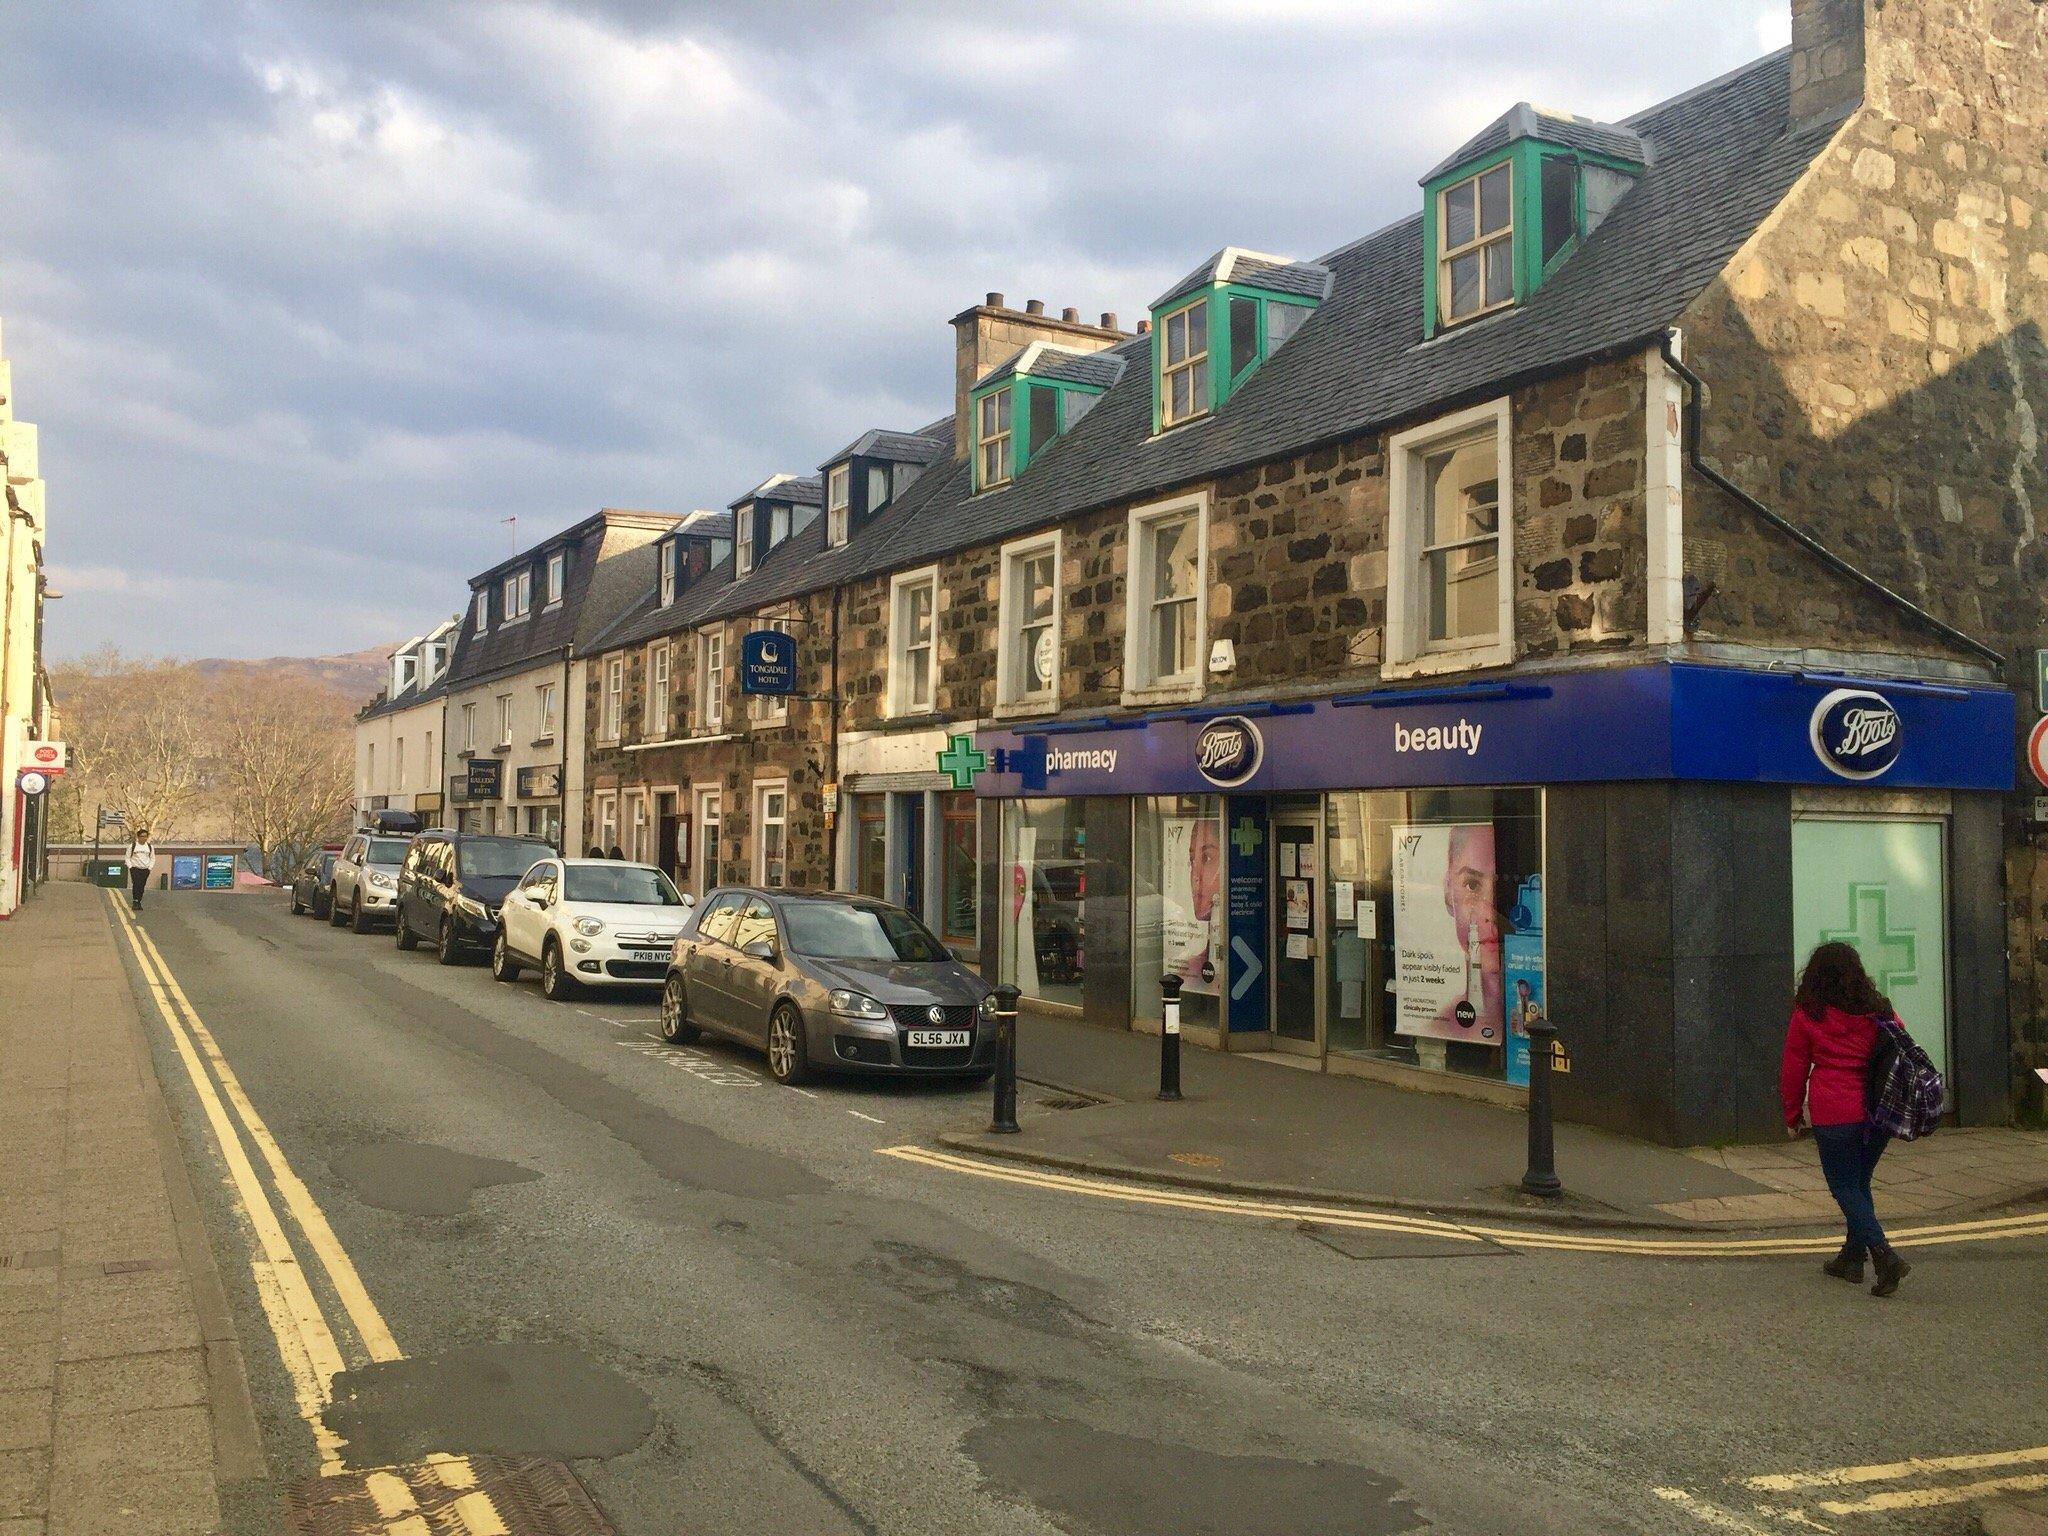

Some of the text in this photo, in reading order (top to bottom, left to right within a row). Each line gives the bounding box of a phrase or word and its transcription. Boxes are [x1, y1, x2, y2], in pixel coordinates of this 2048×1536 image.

[758, 676, 780, 684] HOTEL
[1395, 718, 1482, 755] beauty
[1835, 708, 1896, 755] Boots
[1199, 731, 1242, 768] Boots
[1046, 747, 1117, 774] pharmacy
[1231, 876, 1263, 885] welcome
[633, 952, 671, 961] PK18 NYG
[1401, 949, 1434, 960] Dark spots
[1402, 963, 1460, 973] appear visibly faded
[1420, 975, 1425, 983] 2
[1456, 1010, 1474, 1019] new
[913, 1033, 965, 1045] SL56 JXA
